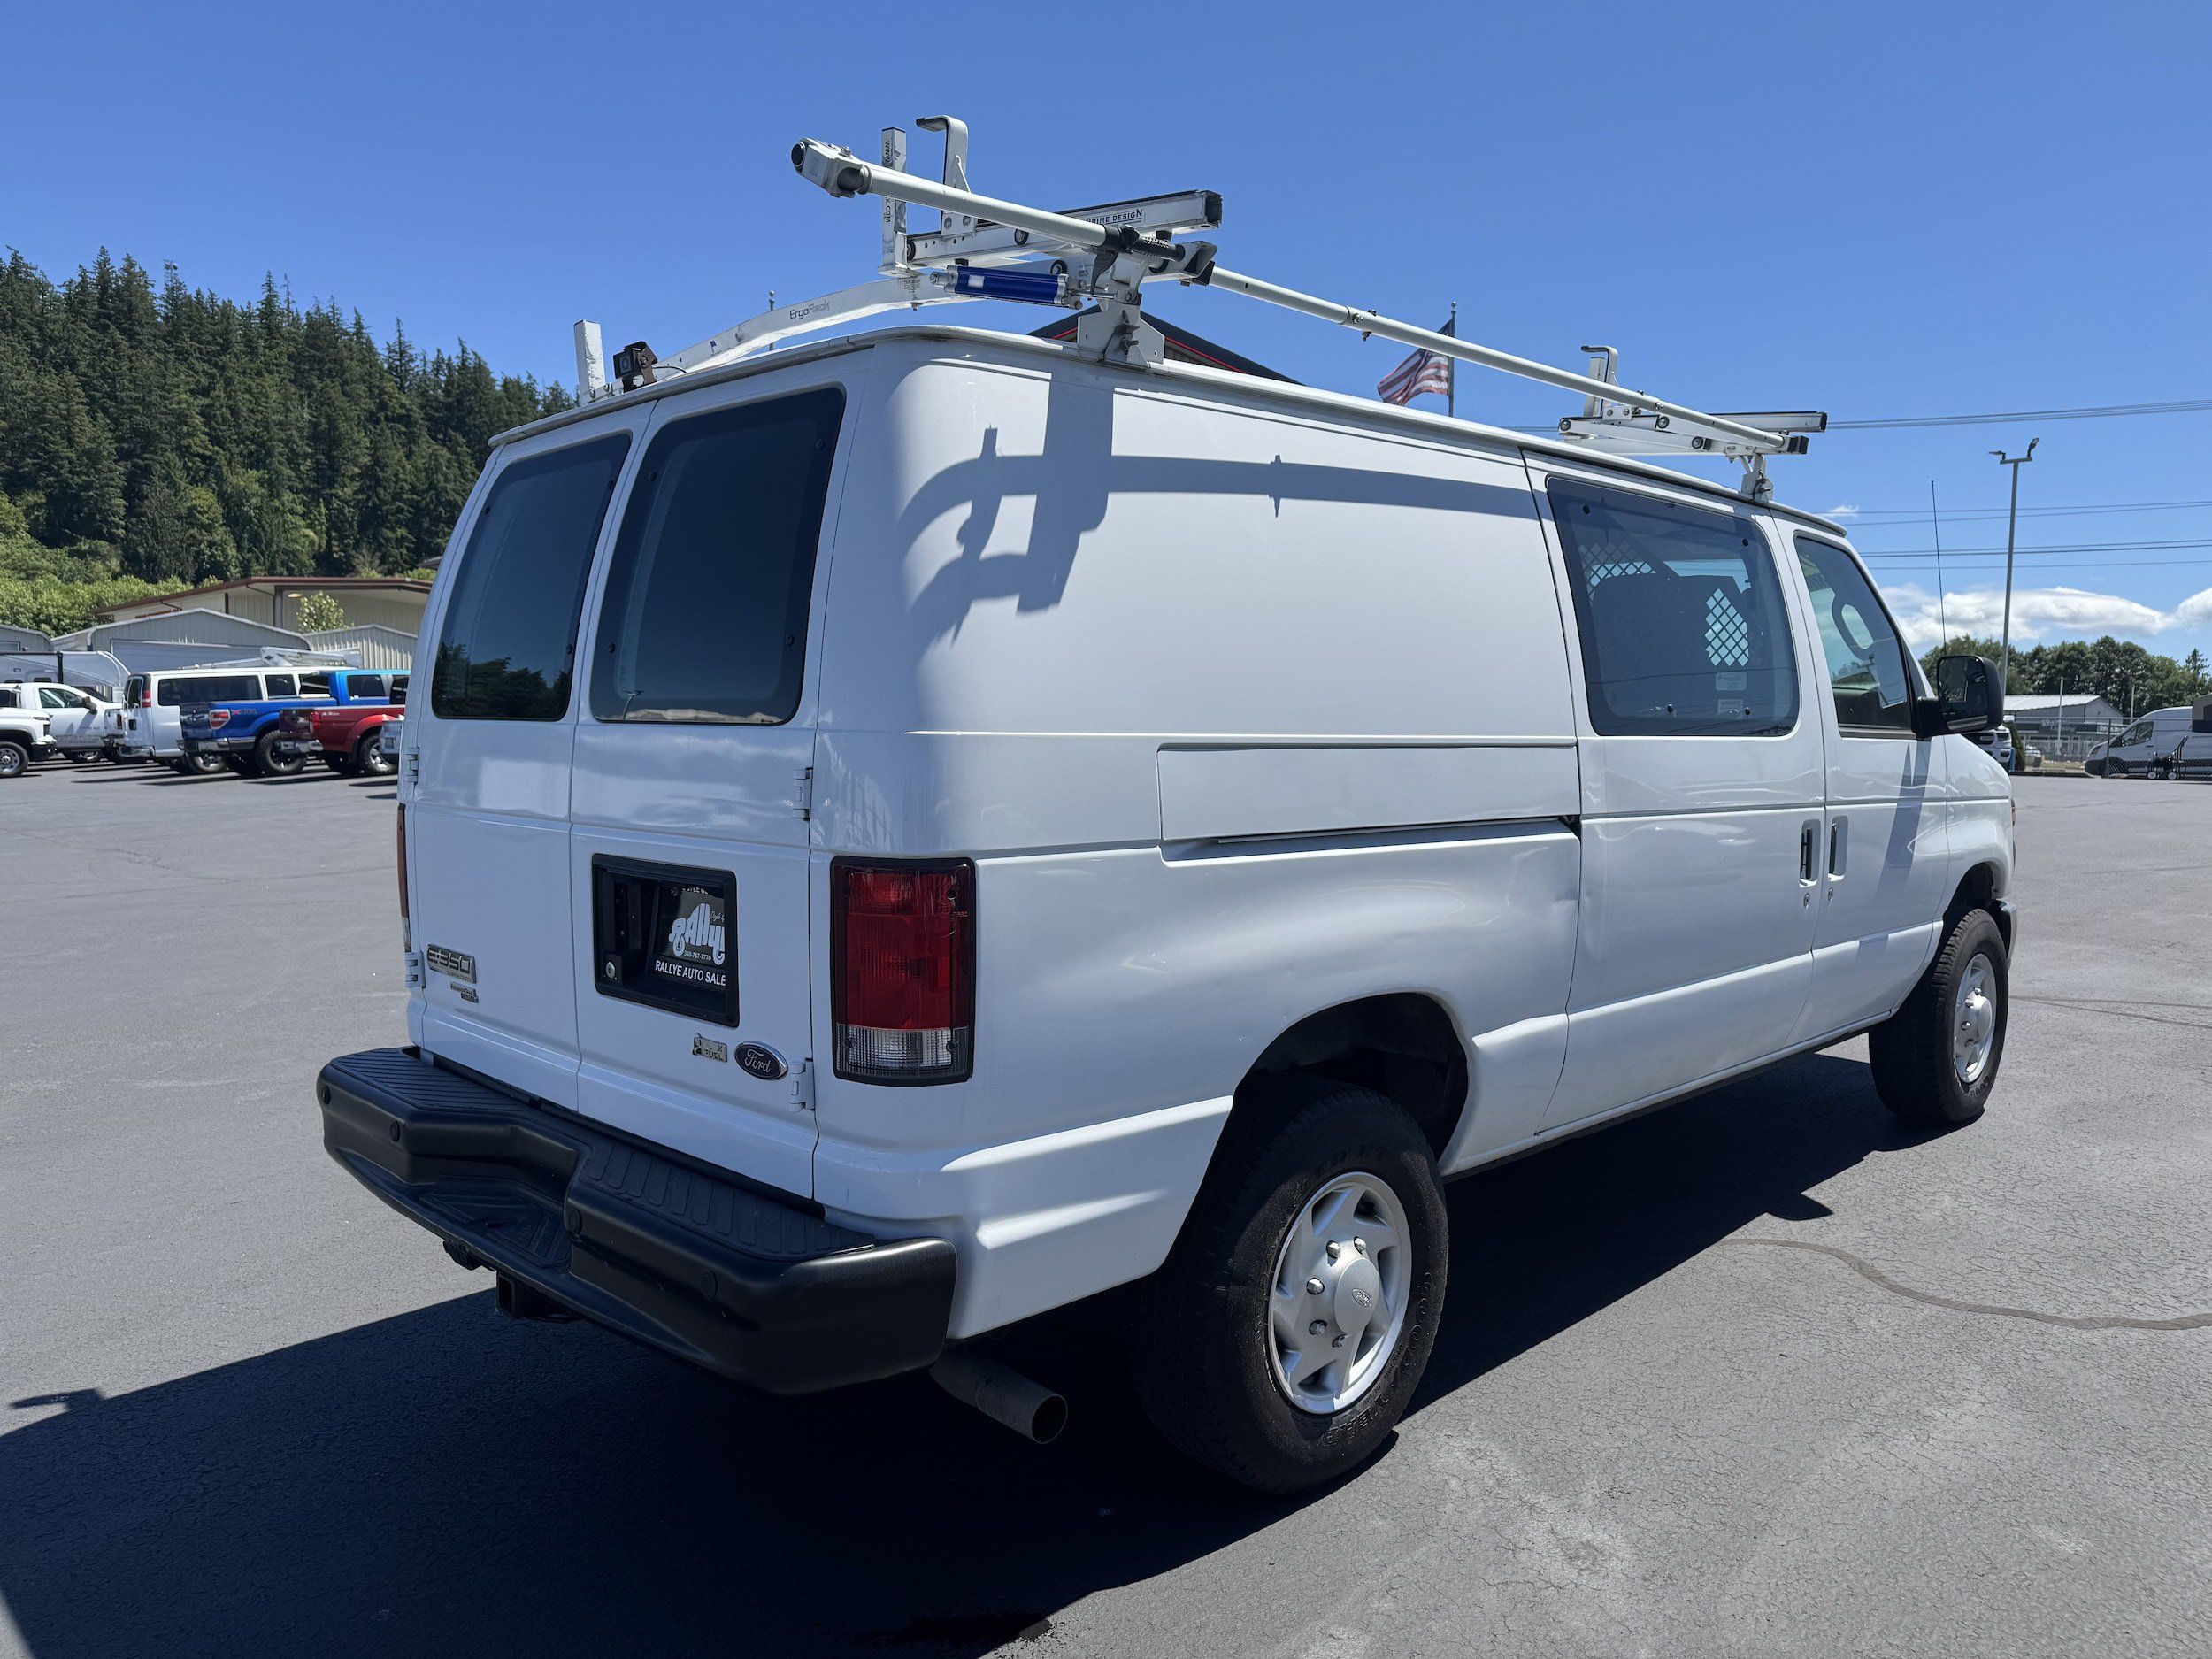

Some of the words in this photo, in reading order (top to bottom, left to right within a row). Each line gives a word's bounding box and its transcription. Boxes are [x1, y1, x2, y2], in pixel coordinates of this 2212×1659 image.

[1112, 208, 1144, 221] DESIGN
[655, 959, 683, 977] RALLYE
[682, 967, 704, 981] AUTO
[704, 971, 726, 987] SALE
[744, 1048, 771, 1072] Ford
